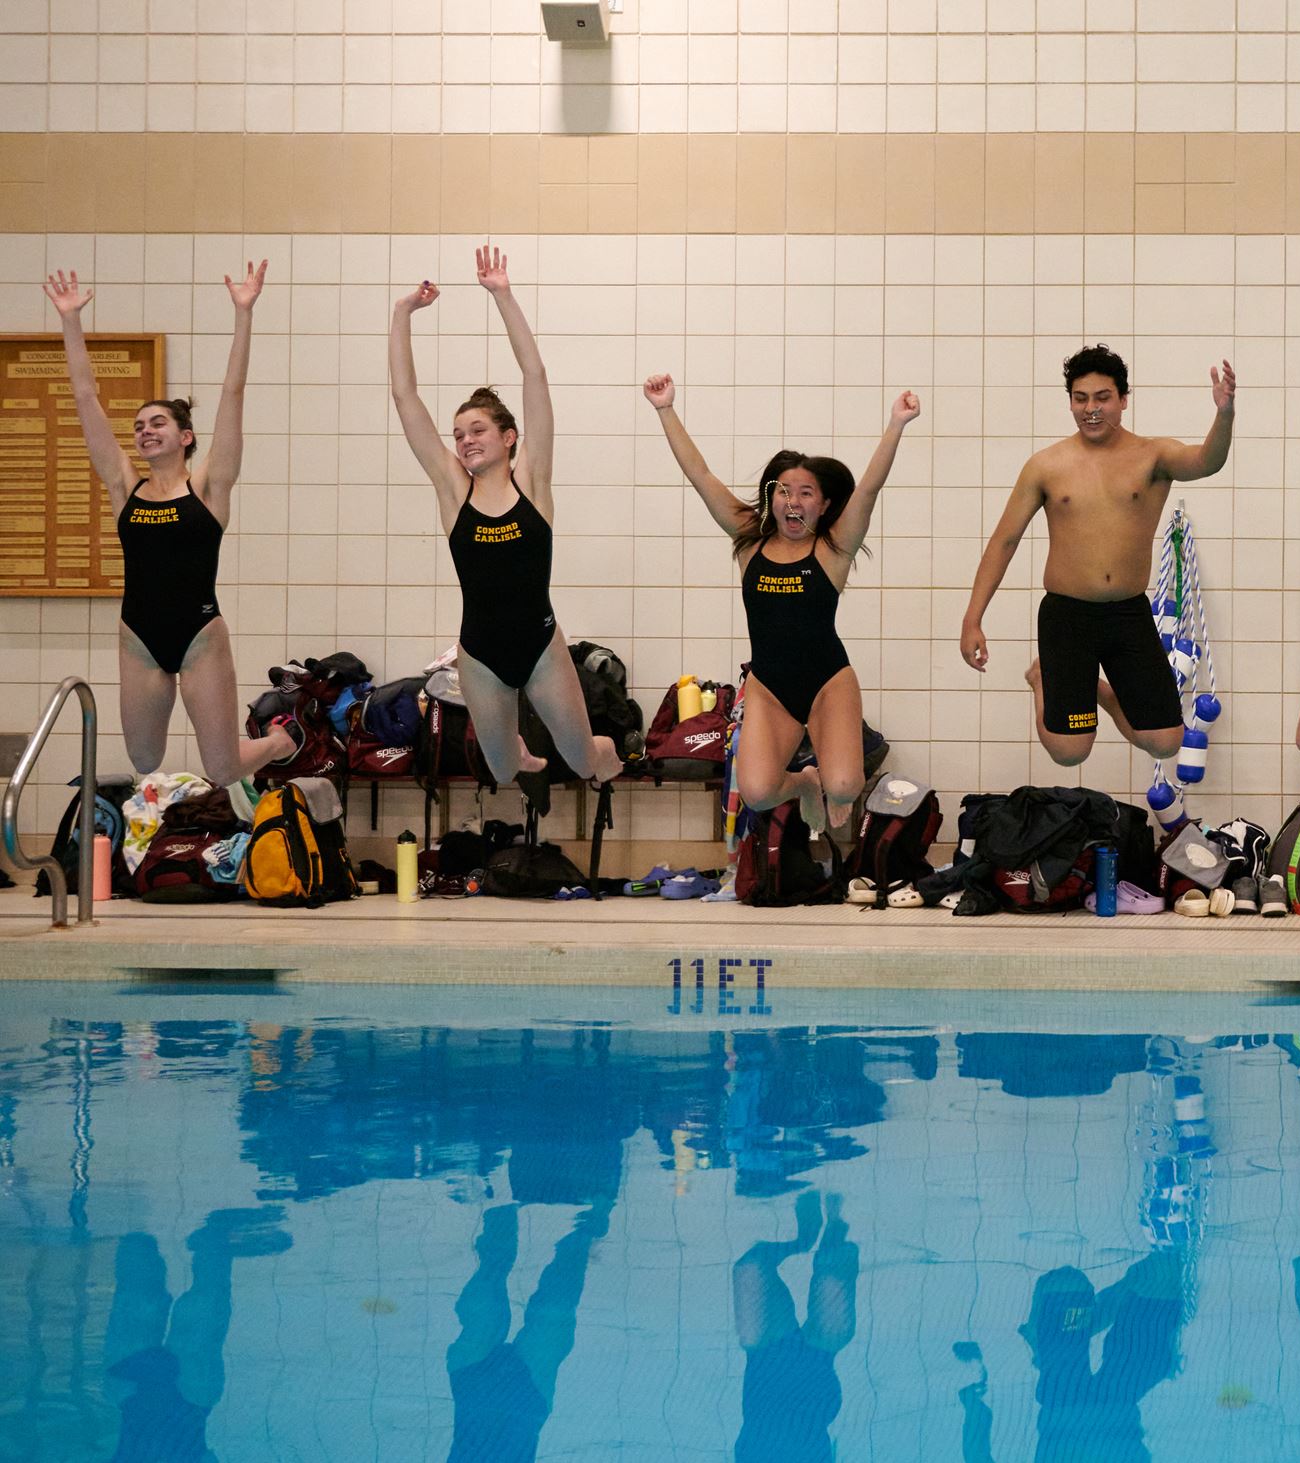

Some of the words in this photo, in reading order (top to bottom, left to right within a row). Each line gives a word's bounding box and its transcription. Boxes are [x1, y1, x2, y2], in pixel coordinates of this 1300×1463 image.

[15, 367, 64, 375] SWIMMING
[97, 367, 130, 375] DIVING
[133, 508, 177, 516] CONCORD
[130, 515, 179, 523] CARLISLE
[476, 522, 518, 534] CONCORD
[475, 530, 522, 542] CARLISLE
[760, 575, 802, 584] CONCORD
[757, 584, 804, 593] CARLISLE
[684, 731, 721, 744] speedo
